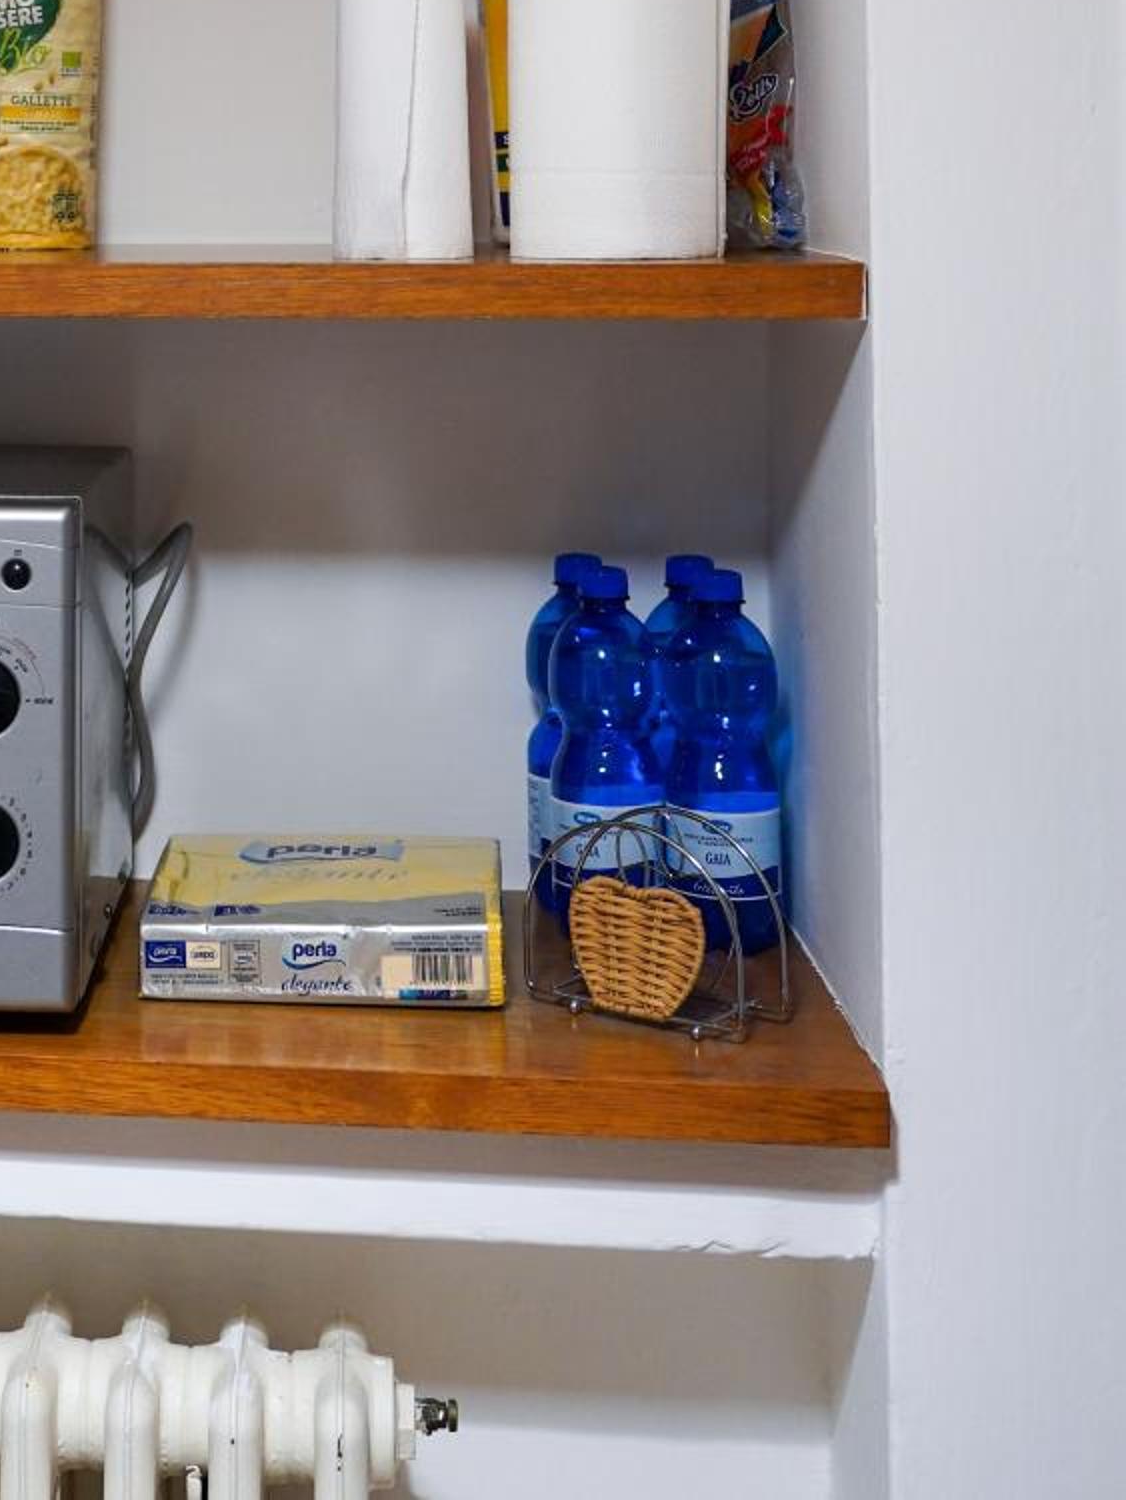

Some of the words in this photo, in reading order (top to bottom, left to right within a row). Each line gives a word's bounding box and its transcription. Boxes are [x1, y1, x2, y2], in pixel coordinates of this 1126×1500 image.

[11, 95, 72, 107] GALLETTE
[266, 843, 378, 858] perla
[293, 940, 337, 961] perla
[281, 974, 352, 996] elegante
